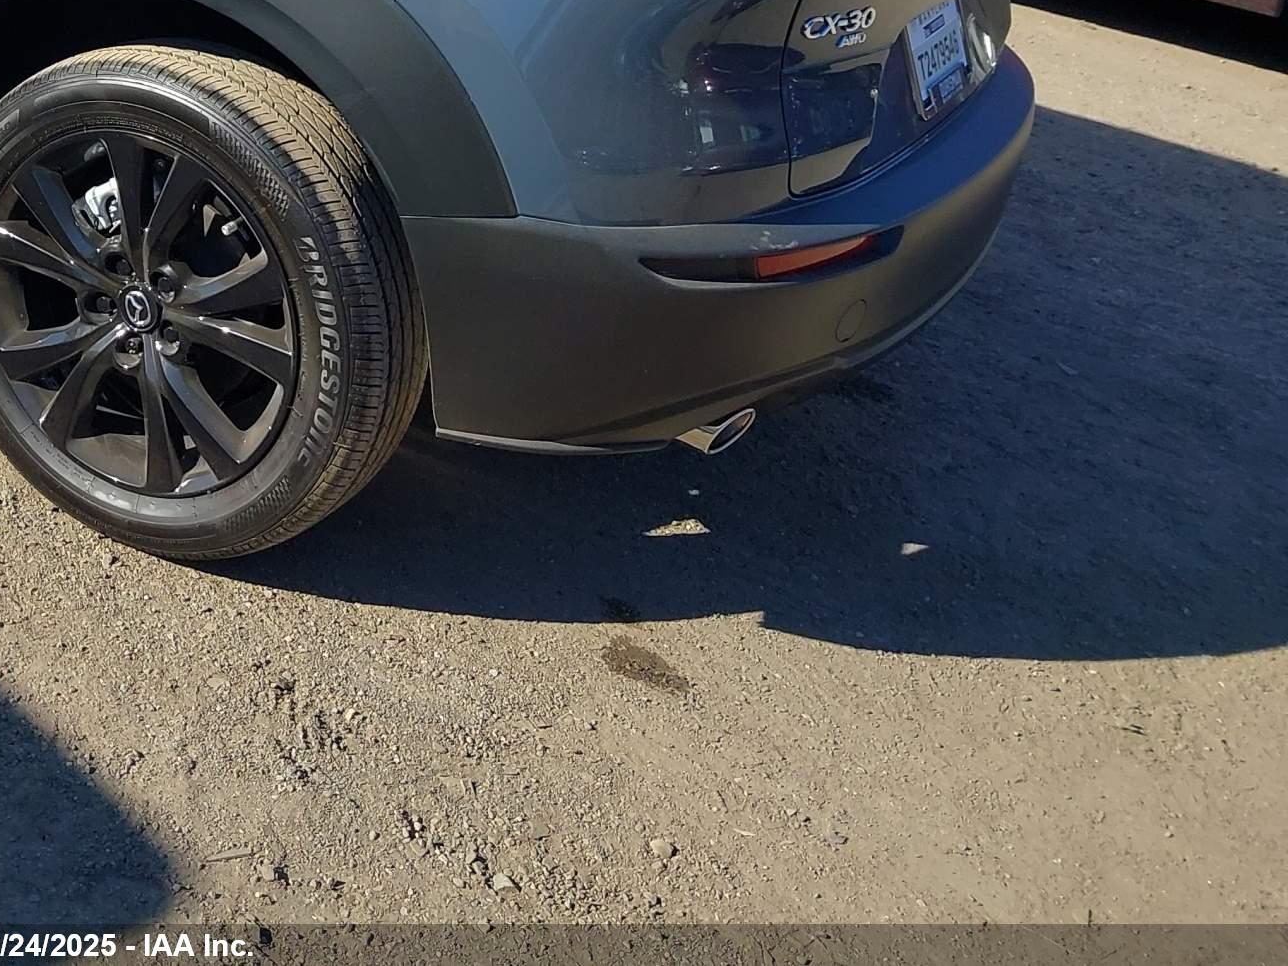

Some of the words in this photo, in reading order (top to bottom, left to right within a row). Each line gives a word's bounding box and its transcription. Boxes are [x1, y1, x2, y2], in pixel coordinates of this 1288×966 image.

[803, 7, 876, 39] CX-30
[836, 33, 867, 48] AWD
[294, 236, 342, 467] BRIDGESTONE
